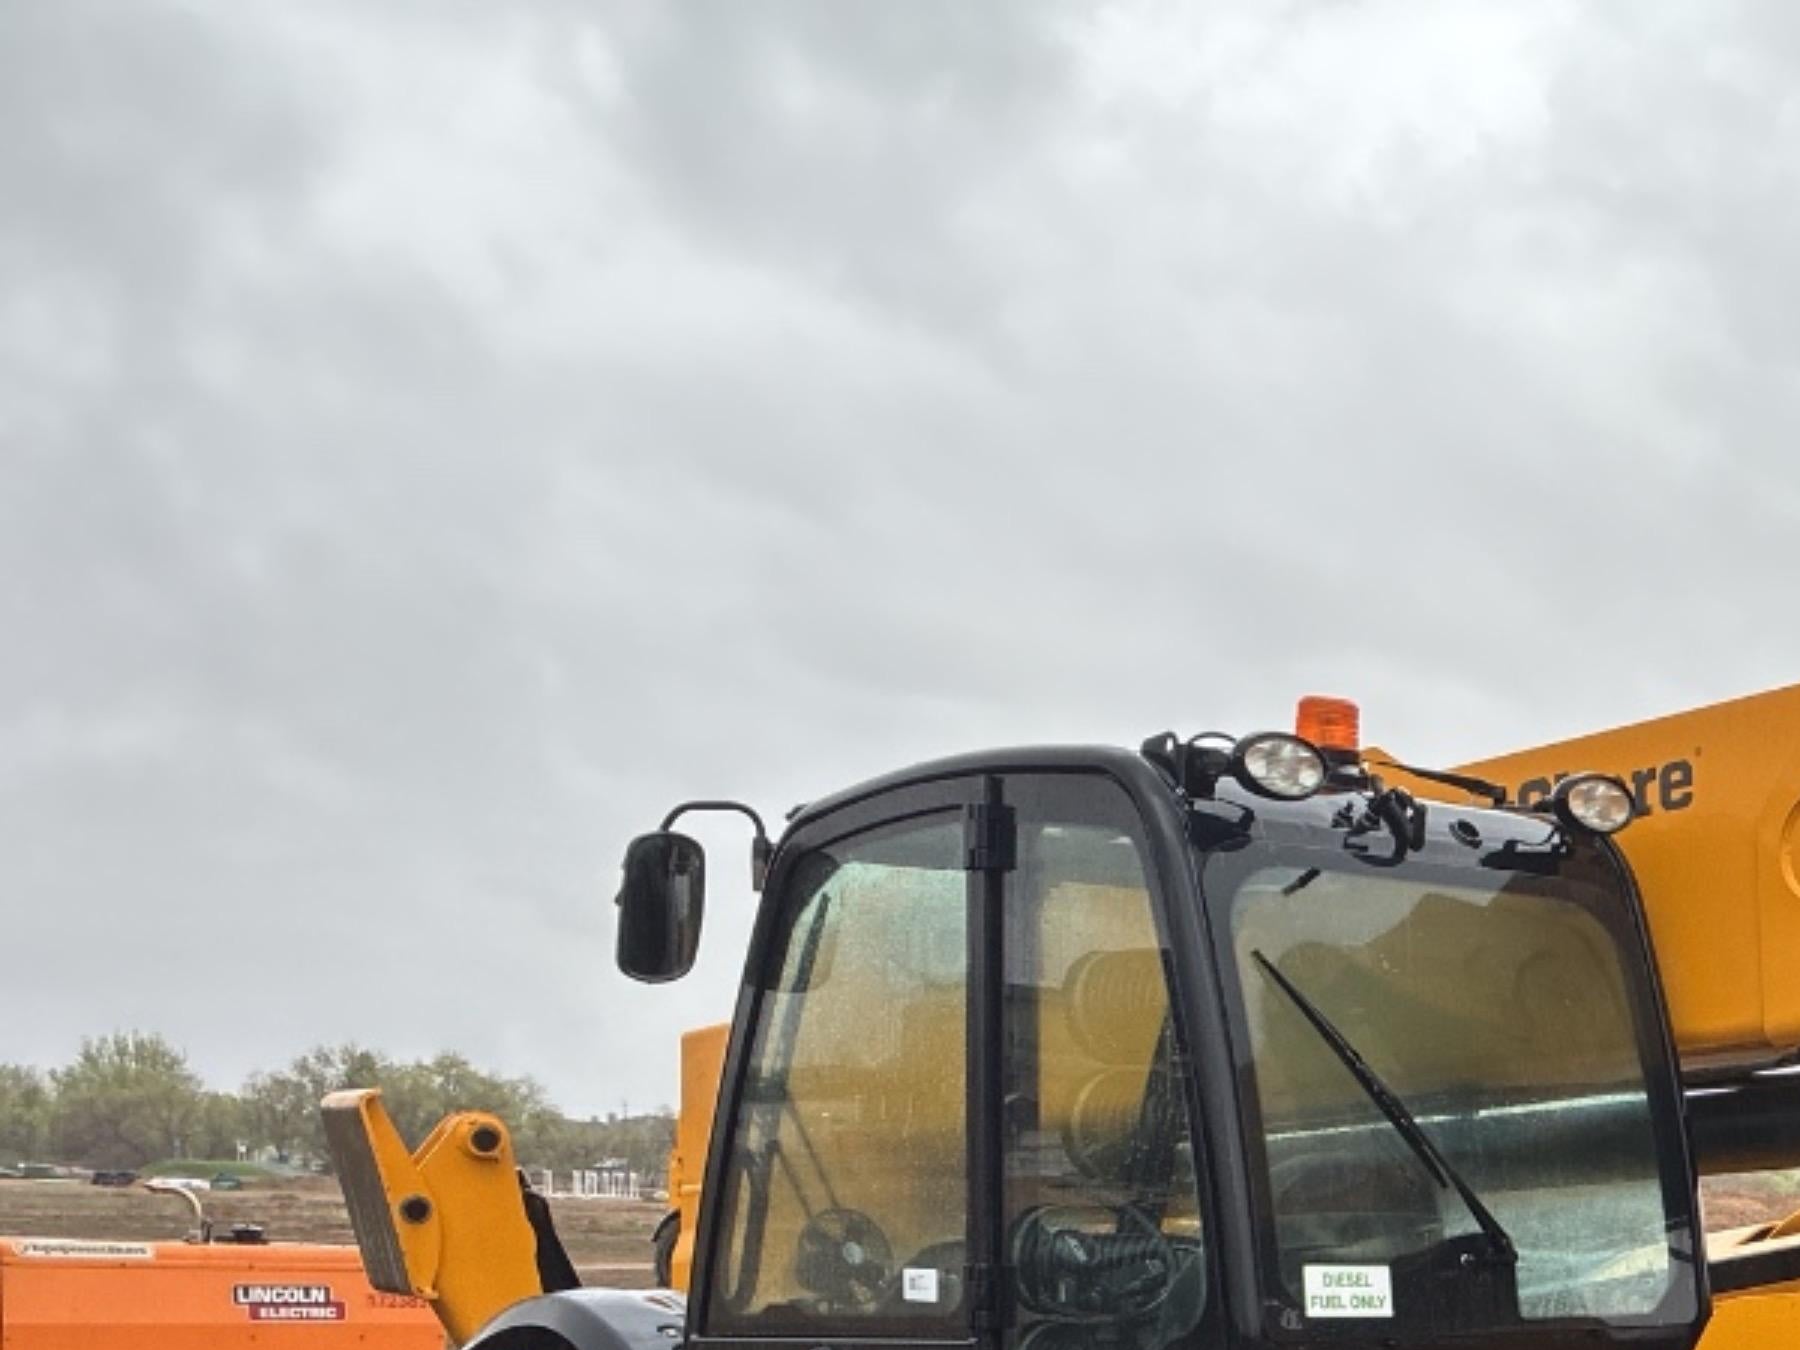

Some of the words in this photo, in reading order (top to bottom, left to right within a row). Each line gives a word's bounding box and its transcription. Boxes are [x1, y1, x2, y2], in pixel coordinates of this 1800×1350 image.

[1322, 1272, 1373, 1288] DIESEL
[236, 1286, 325, 1303] LINCOLN
[1310, 1295, 1346, 1309] FUEL
[1349, 1295, 1387, 1309] ONLY
[259, 1307, 337, 1319] ELECTRIC
